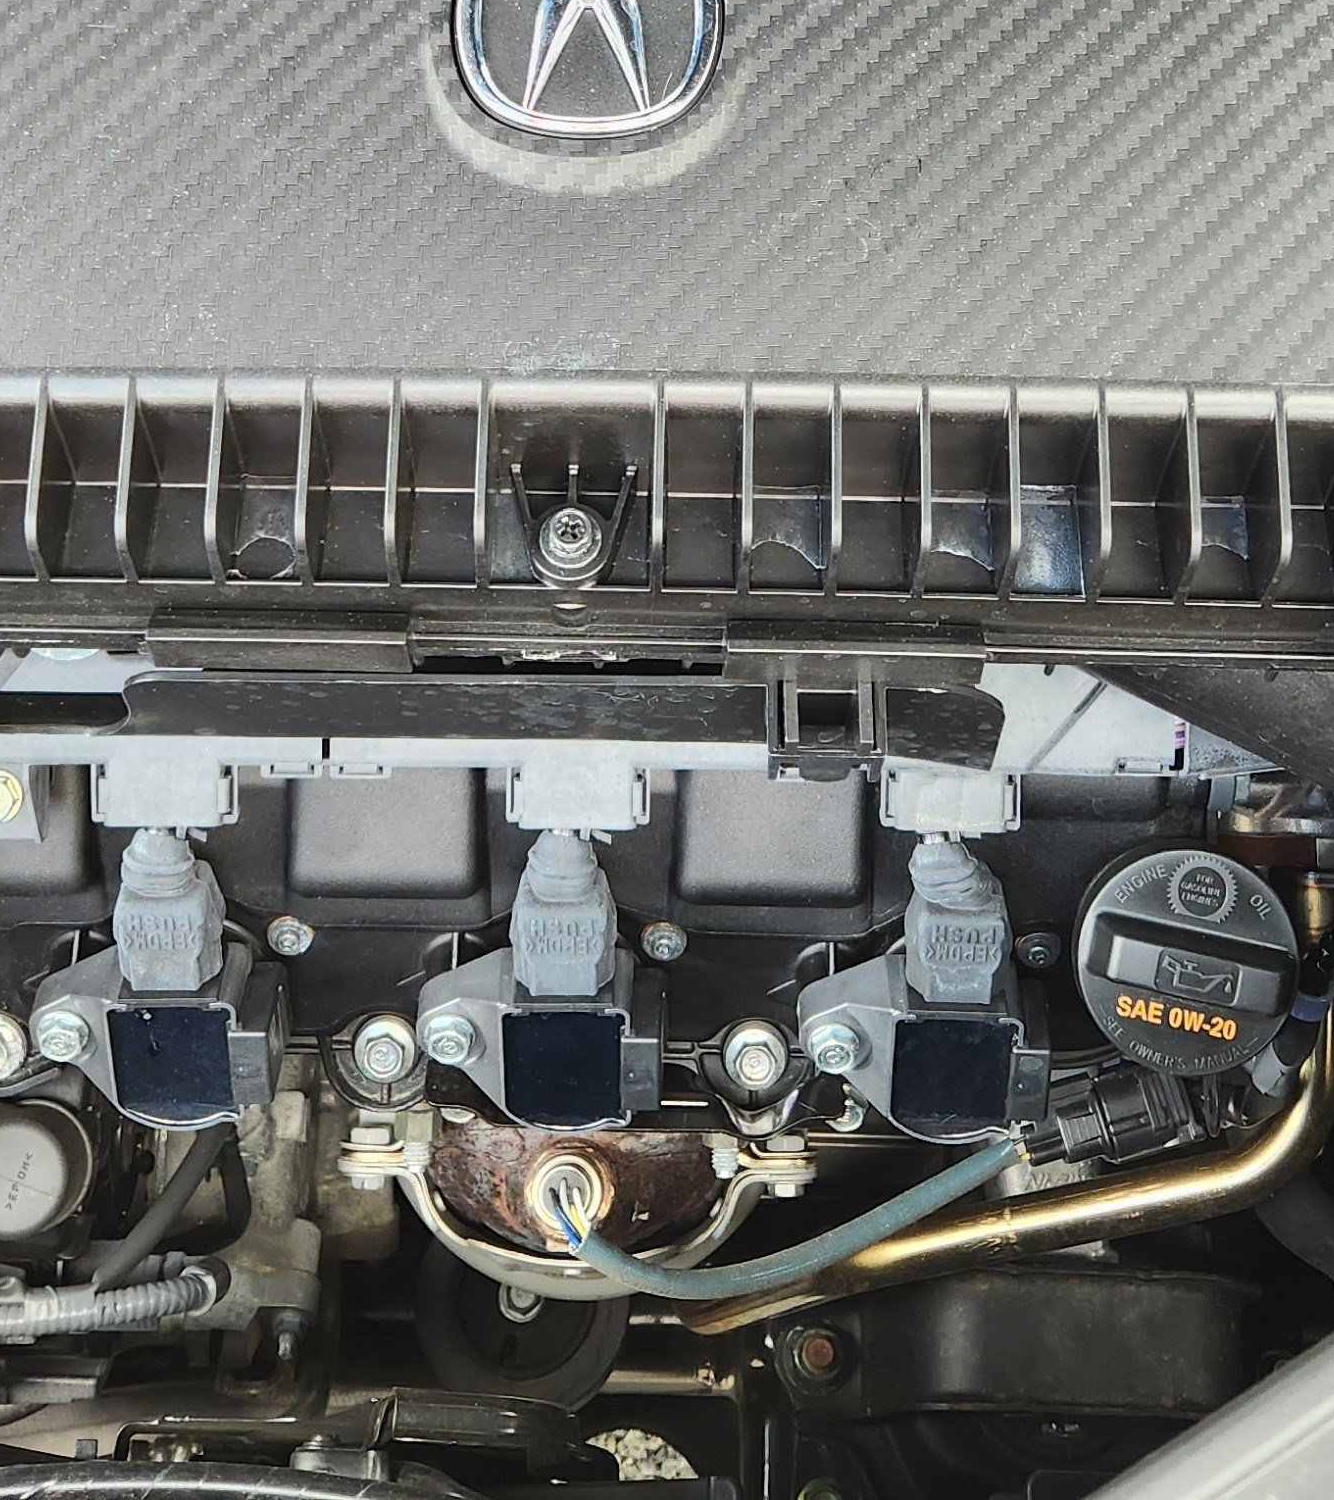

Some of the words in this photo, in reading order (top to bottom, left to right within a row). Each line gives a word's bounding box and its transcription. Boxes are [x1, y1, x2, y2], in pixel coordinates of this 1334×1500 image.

[1196, 873, 1214, 885] FOR
[1114, 864, 1168, 905] ENGINE
[1249, 894, 1273, 921] OIL
[128, 913, 192, 932] PUSH
[530, 919, 595, 937] PUSH
[931, 924, 997, 944] PUSH
[1115, 994, 1165, 1025] SAE
[1168, 1007, 1238, 1041] 0W-20
[1103, 1015, 1125, 1040] SEE
[1128, 1040, 1186, 1070] OWNER'S
[1194, 1046, 1251, 1070] MANUAL
